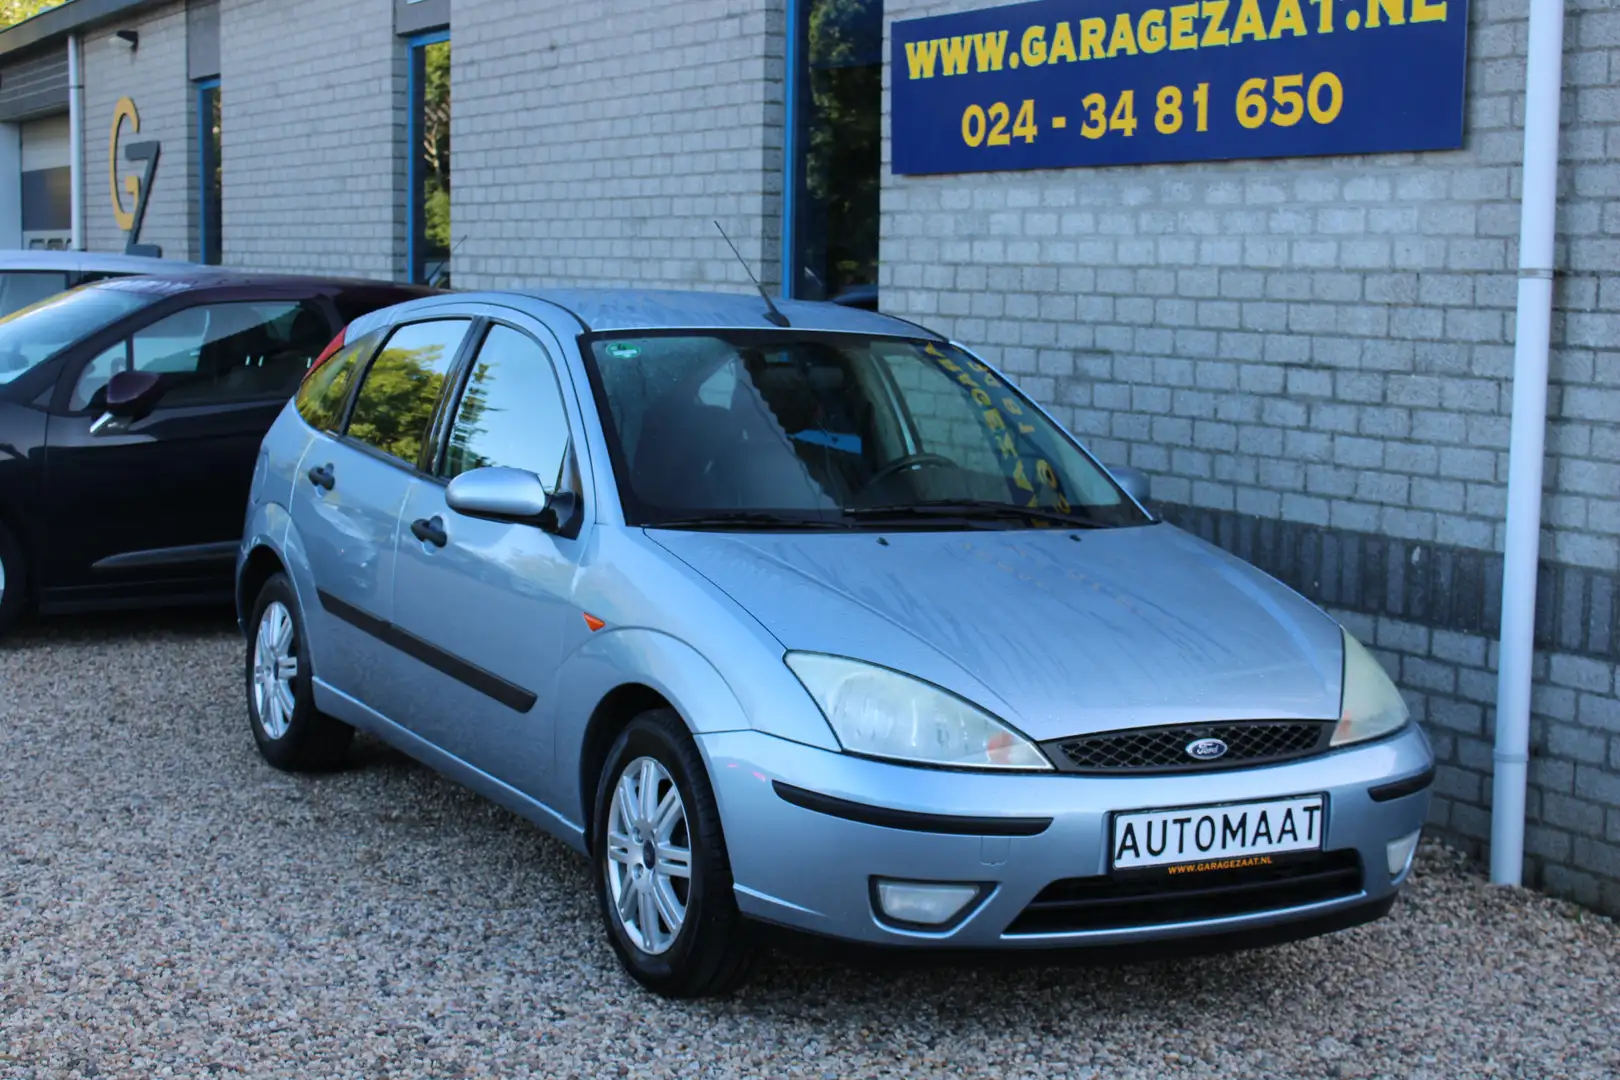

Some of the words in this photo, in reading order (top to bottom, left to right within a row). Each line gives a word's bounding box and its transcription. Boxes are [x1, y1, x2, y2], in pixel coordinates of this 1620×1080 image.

[961, 99, 1038, 147] 024
[1080, 90, 1137, 140] 34
[1154, 83, 1209, 135] 81
[1236, 71, 1343, 130] 650
[1115, 805, 1321, 860] AUTOMAAT
[1167, 856, 1273, 875] WWW.GARAGEZAAT.NL
